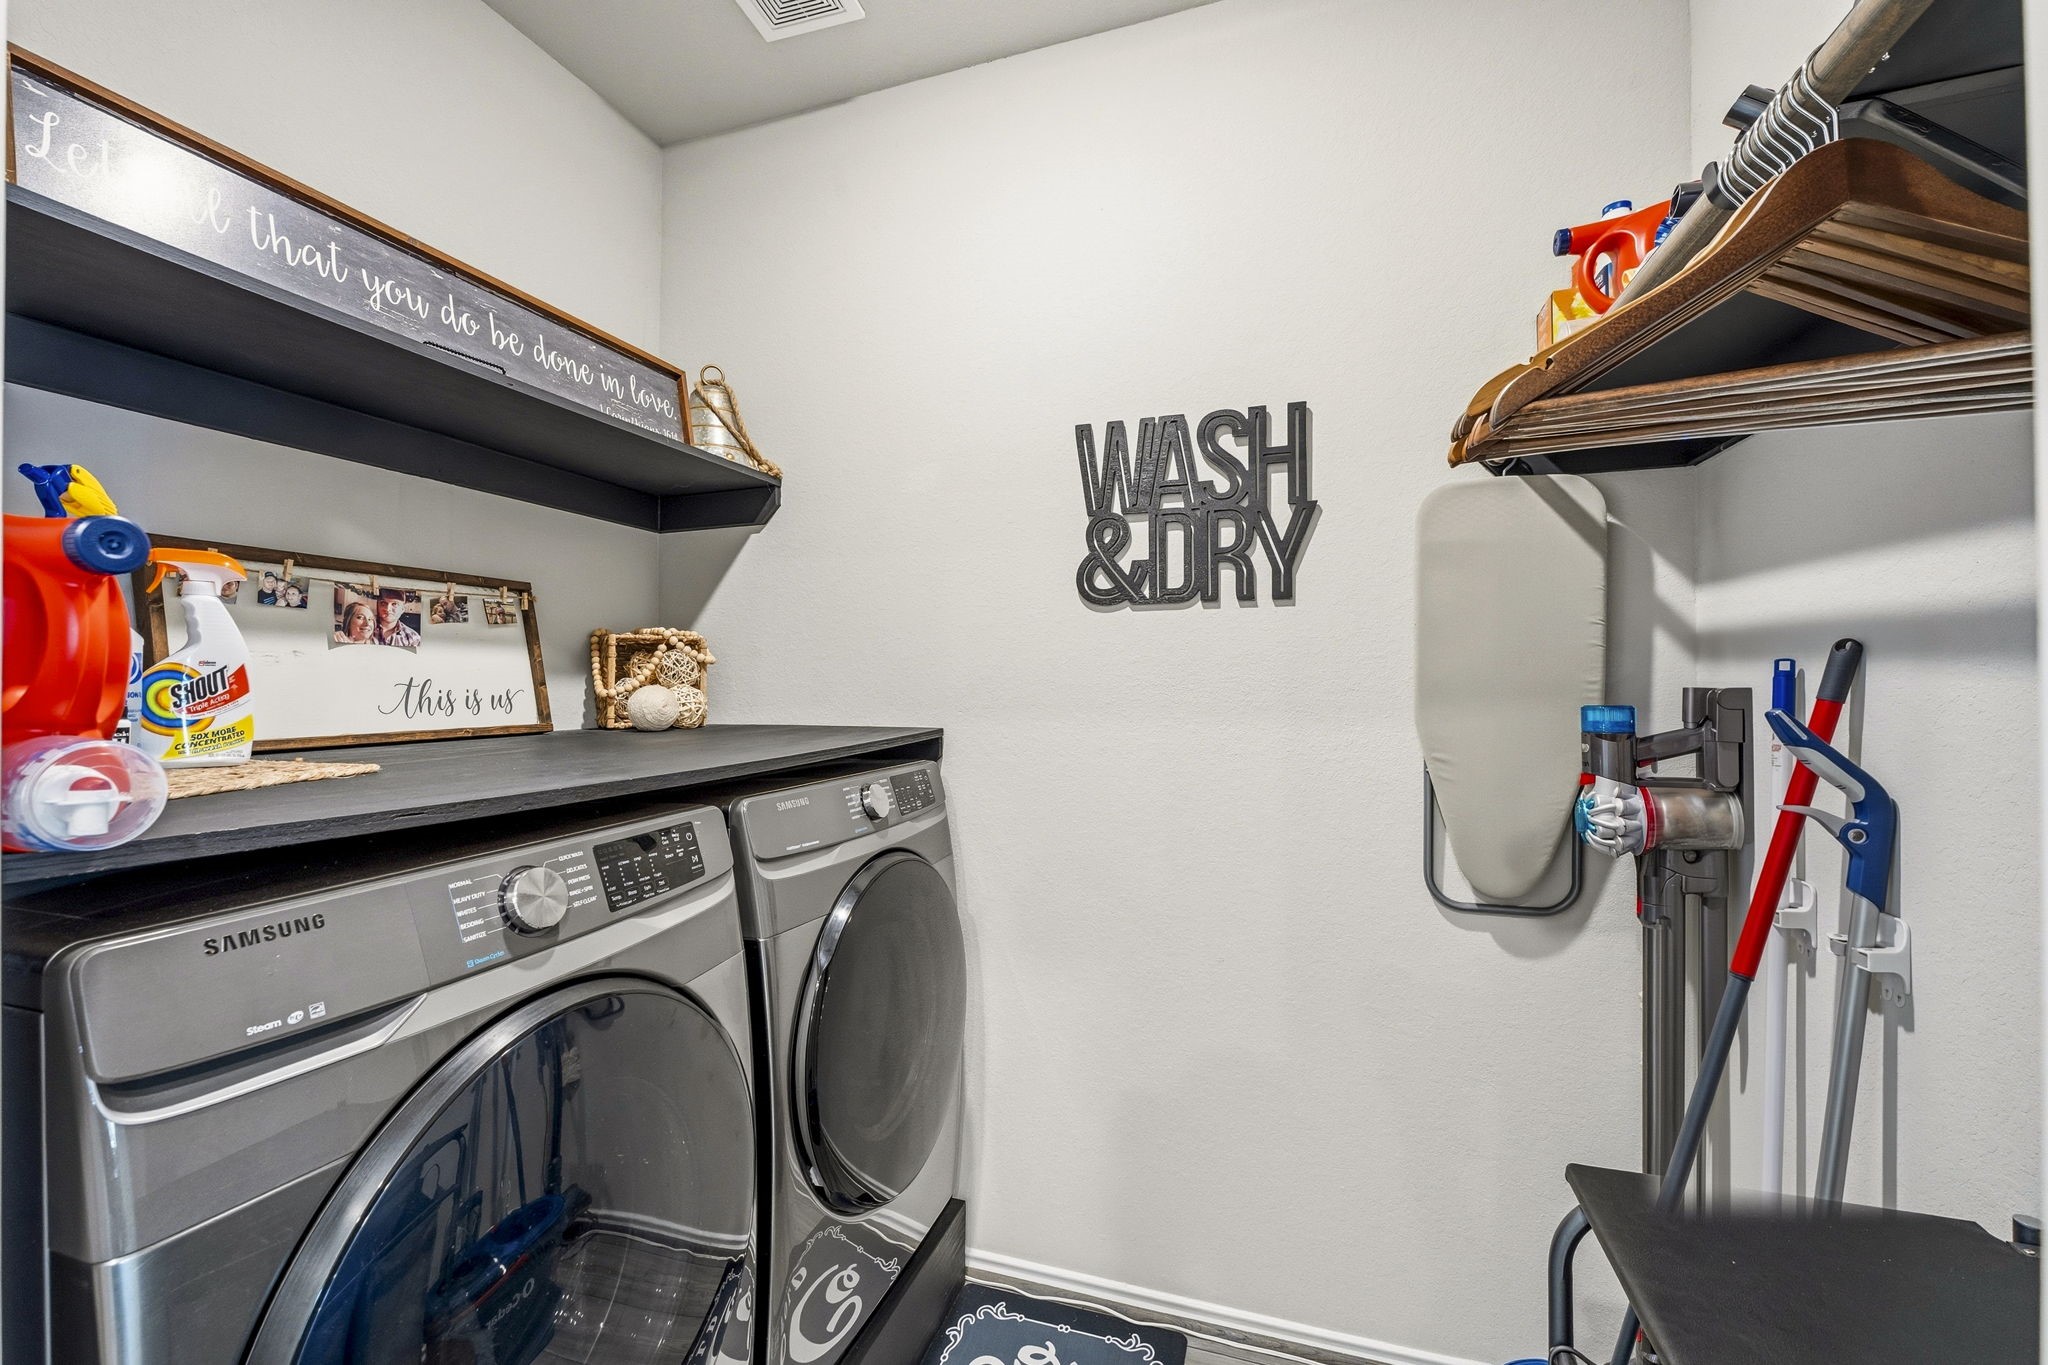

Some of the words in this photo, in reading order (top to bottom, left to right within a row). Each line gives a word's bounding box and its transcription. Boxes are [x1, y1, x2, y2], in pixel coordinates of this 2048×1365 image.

[247, 205, 348, 283] that
[361, 267, 429, 319] you
[440, 293, 480, 336] do
[489, 311, 524, 356] be
[533, 334, 594, 385] done
[599, 363, 624, 399] in
[629, 373, 678, 420] love.
[1075, 401, 1308, 516] WASH
[1149, 500, 1318, 602] DRY
[170, 665, 228, 709] SHOUT
[189, 701, 209, 713] Triple
[209, 693, 230, 706] Action
[377, 676, 457, 719] this
[465, 688, 483, 716] is
[490, 688, 525, 714] us
[190, 731, 210, 742] 50X
[211, 726, 237, 738] MORE
[776, 797, 810, 811] SAMSUNG
[203, 914, 326, 956] SAMSUNG
[246, 1019, 283, 1037] Steam
